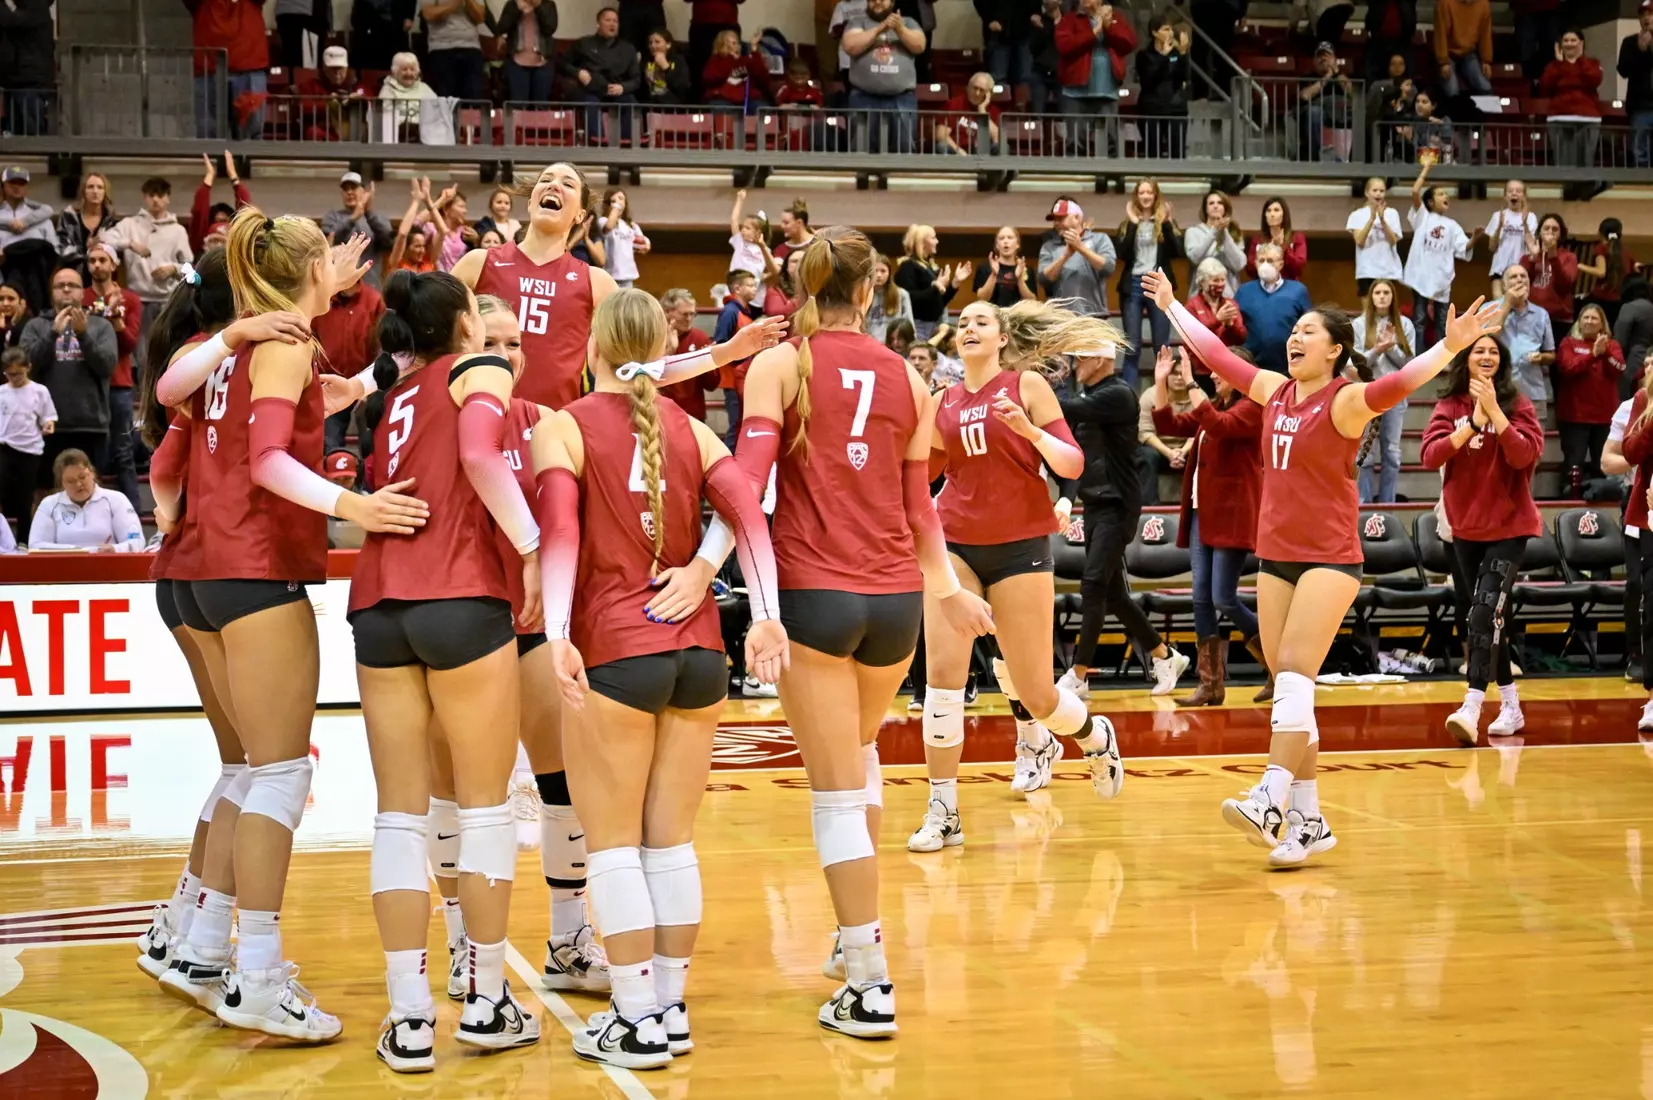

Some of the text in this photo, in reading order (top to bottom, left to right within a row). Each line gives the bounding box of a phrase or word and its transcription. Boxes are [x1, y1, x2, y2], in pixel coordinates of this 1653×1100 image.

[519, 276, 556, 297] WSU
[518, 295, 551, 335] 15
[204, 354, 237, 420] 16
[837, 367, 876, 437] 7
[388, 384, 420, 455] 5
[959, 403, 988, 424] WSU
[1273, 413, 1302, 433] WSU
[959, 421, 988, 457] 10
[1271, 433, 1293, 471] 17
